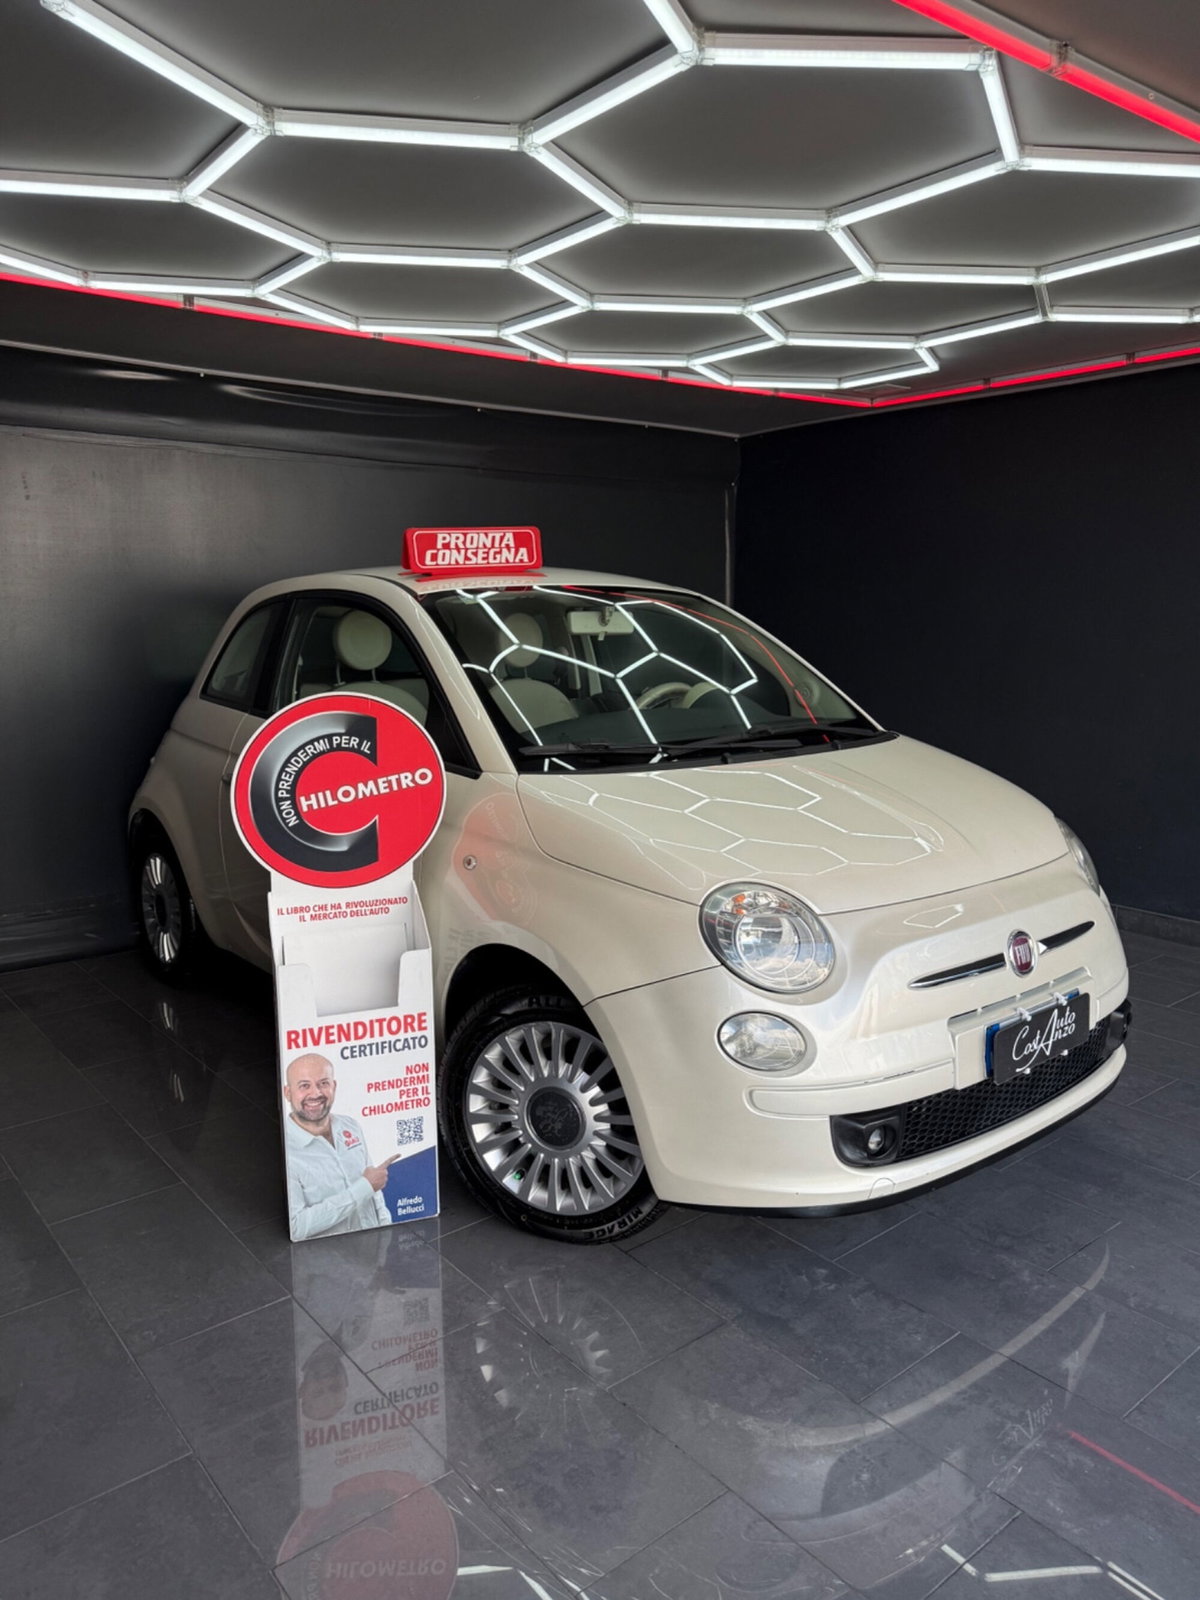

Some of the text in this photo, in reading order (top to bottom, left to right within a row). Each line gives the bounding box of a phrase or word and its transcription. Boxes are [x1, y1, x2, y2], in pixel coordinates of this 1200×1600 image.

[436, 532, 516, 549] PRONTA
[425, 547, 529, 566] CONSEGNA
[278, 735, 372, 827] NON PRENDERMI PER IL
[277, 896, 408, 916] IL LIBRO CHE HA RIVOLUZIONATO
[299, 906, 390, 923] IL MERCATO DELL'AUTO
[286, 1012, 428, 1050] RIVENDITORE
[340, 1034, 428, 1060] CERTIFICATO
[405, 1062, 430, 1076] NON
[366, 1074, 430, 1093] PRENDERMI
[399, 1085, 431, 1099] PER IL
[361, 1097, 431, 1117] CHILOMETRO
[397, 1195, 423, 1207] Alfredo
[397, 1204, 425, 1216] Bellucci
[584, 1207, 644, 1240] MIRAGE
